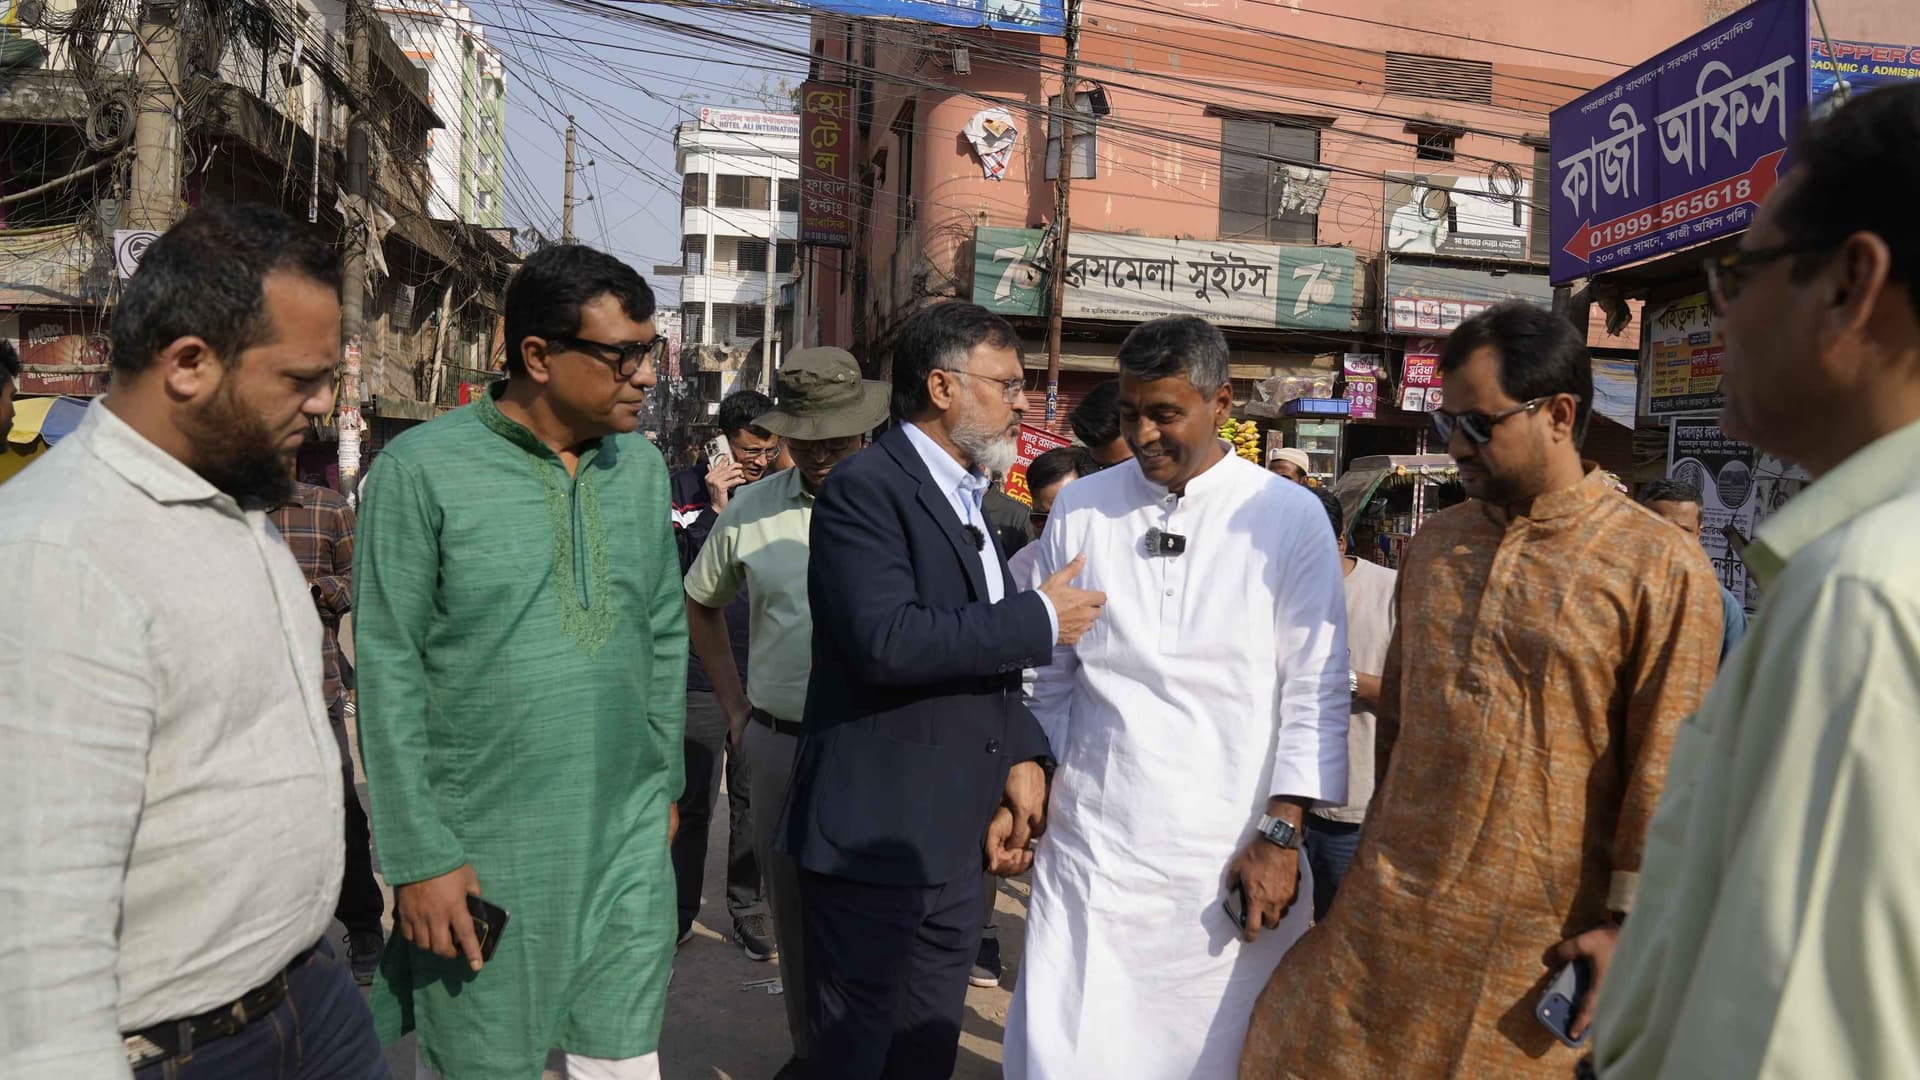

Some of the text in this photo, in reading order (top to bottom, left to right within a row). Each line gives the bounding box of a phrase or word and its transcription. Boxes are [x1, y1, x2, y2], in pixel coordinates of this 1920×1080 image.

[1626, 65, 1665, 91] বাংলাদেশ
[1667, 47, 1699, 70] সরকার
[1701, 18, 1755, 52] অনুমোদিত
[1861, 64, 1869, 74] &
[720, 121, 740, 129] HOTEL
[1558, 54, 1797, 218] কাজী অফিস
[1590, 179, 1751, 248] 01999-565618
[1595, 252, 1614, 264] ২০০
[1617, 245, 1631, 257] গজ
[1666, 225, 1690, 242] কাজী
[1693, 215, 1724, 234] অফিস
[1726, 207, 1748, 222] গলি
[1065, 250, 1273, 304] রসমেলা সুইটস
